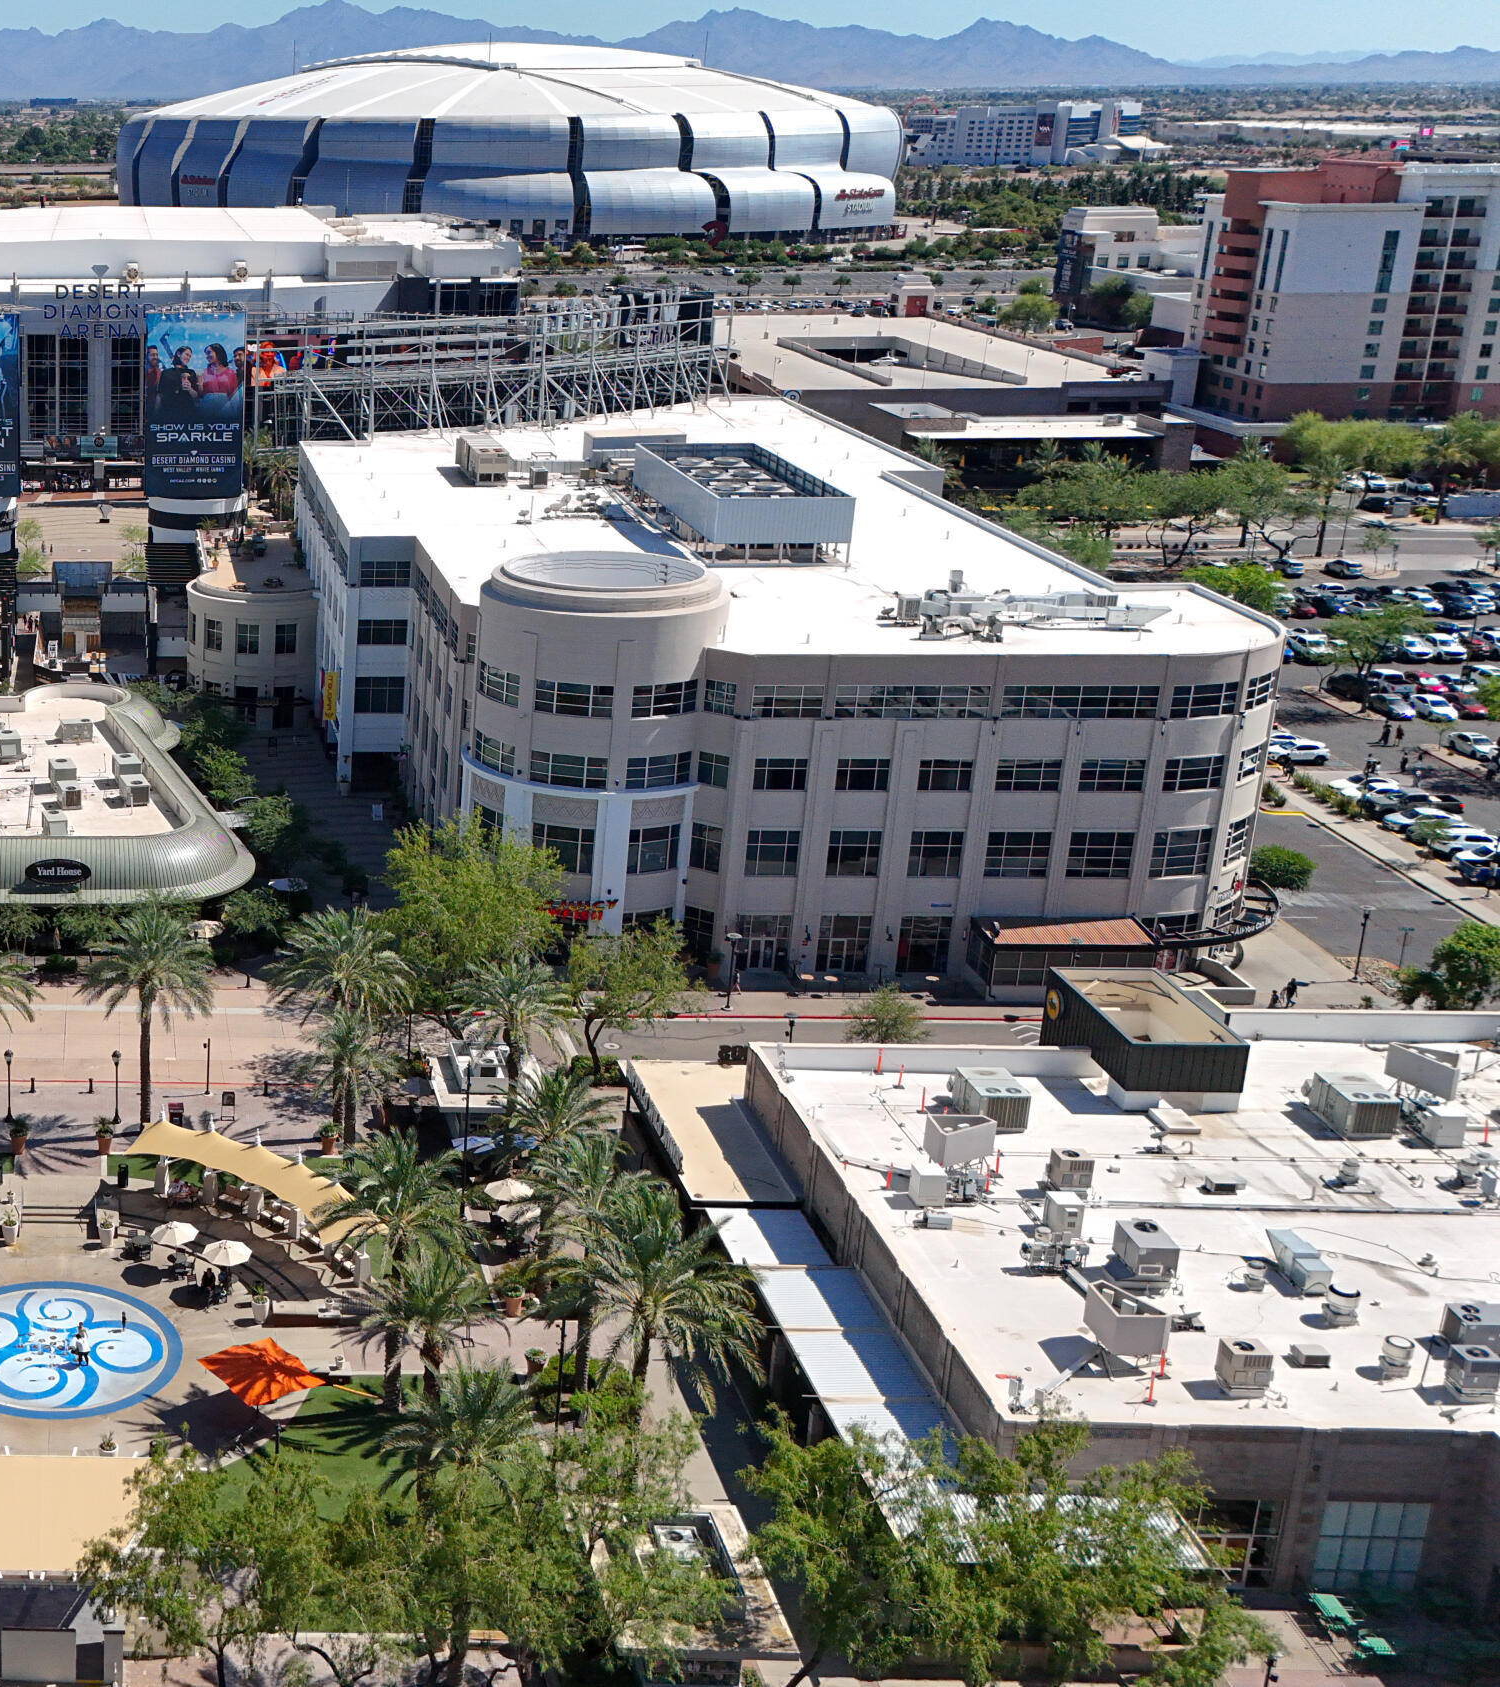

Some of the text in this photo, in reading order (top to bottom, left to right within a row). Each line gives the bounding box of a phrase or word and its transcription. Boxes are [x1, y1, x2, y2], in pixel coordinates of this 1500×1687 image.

[55, 284, 145, 299] DESERT
[60, 323, 140, 339] ARENA
[150, 423, 240, 431] SHOW US YOUR
[156, 432, 233, 442] SPARKLE
[152, 455, 236, 465] DESERT DIAMOND CASINO
[36, 867, 82, 876] Yard House
